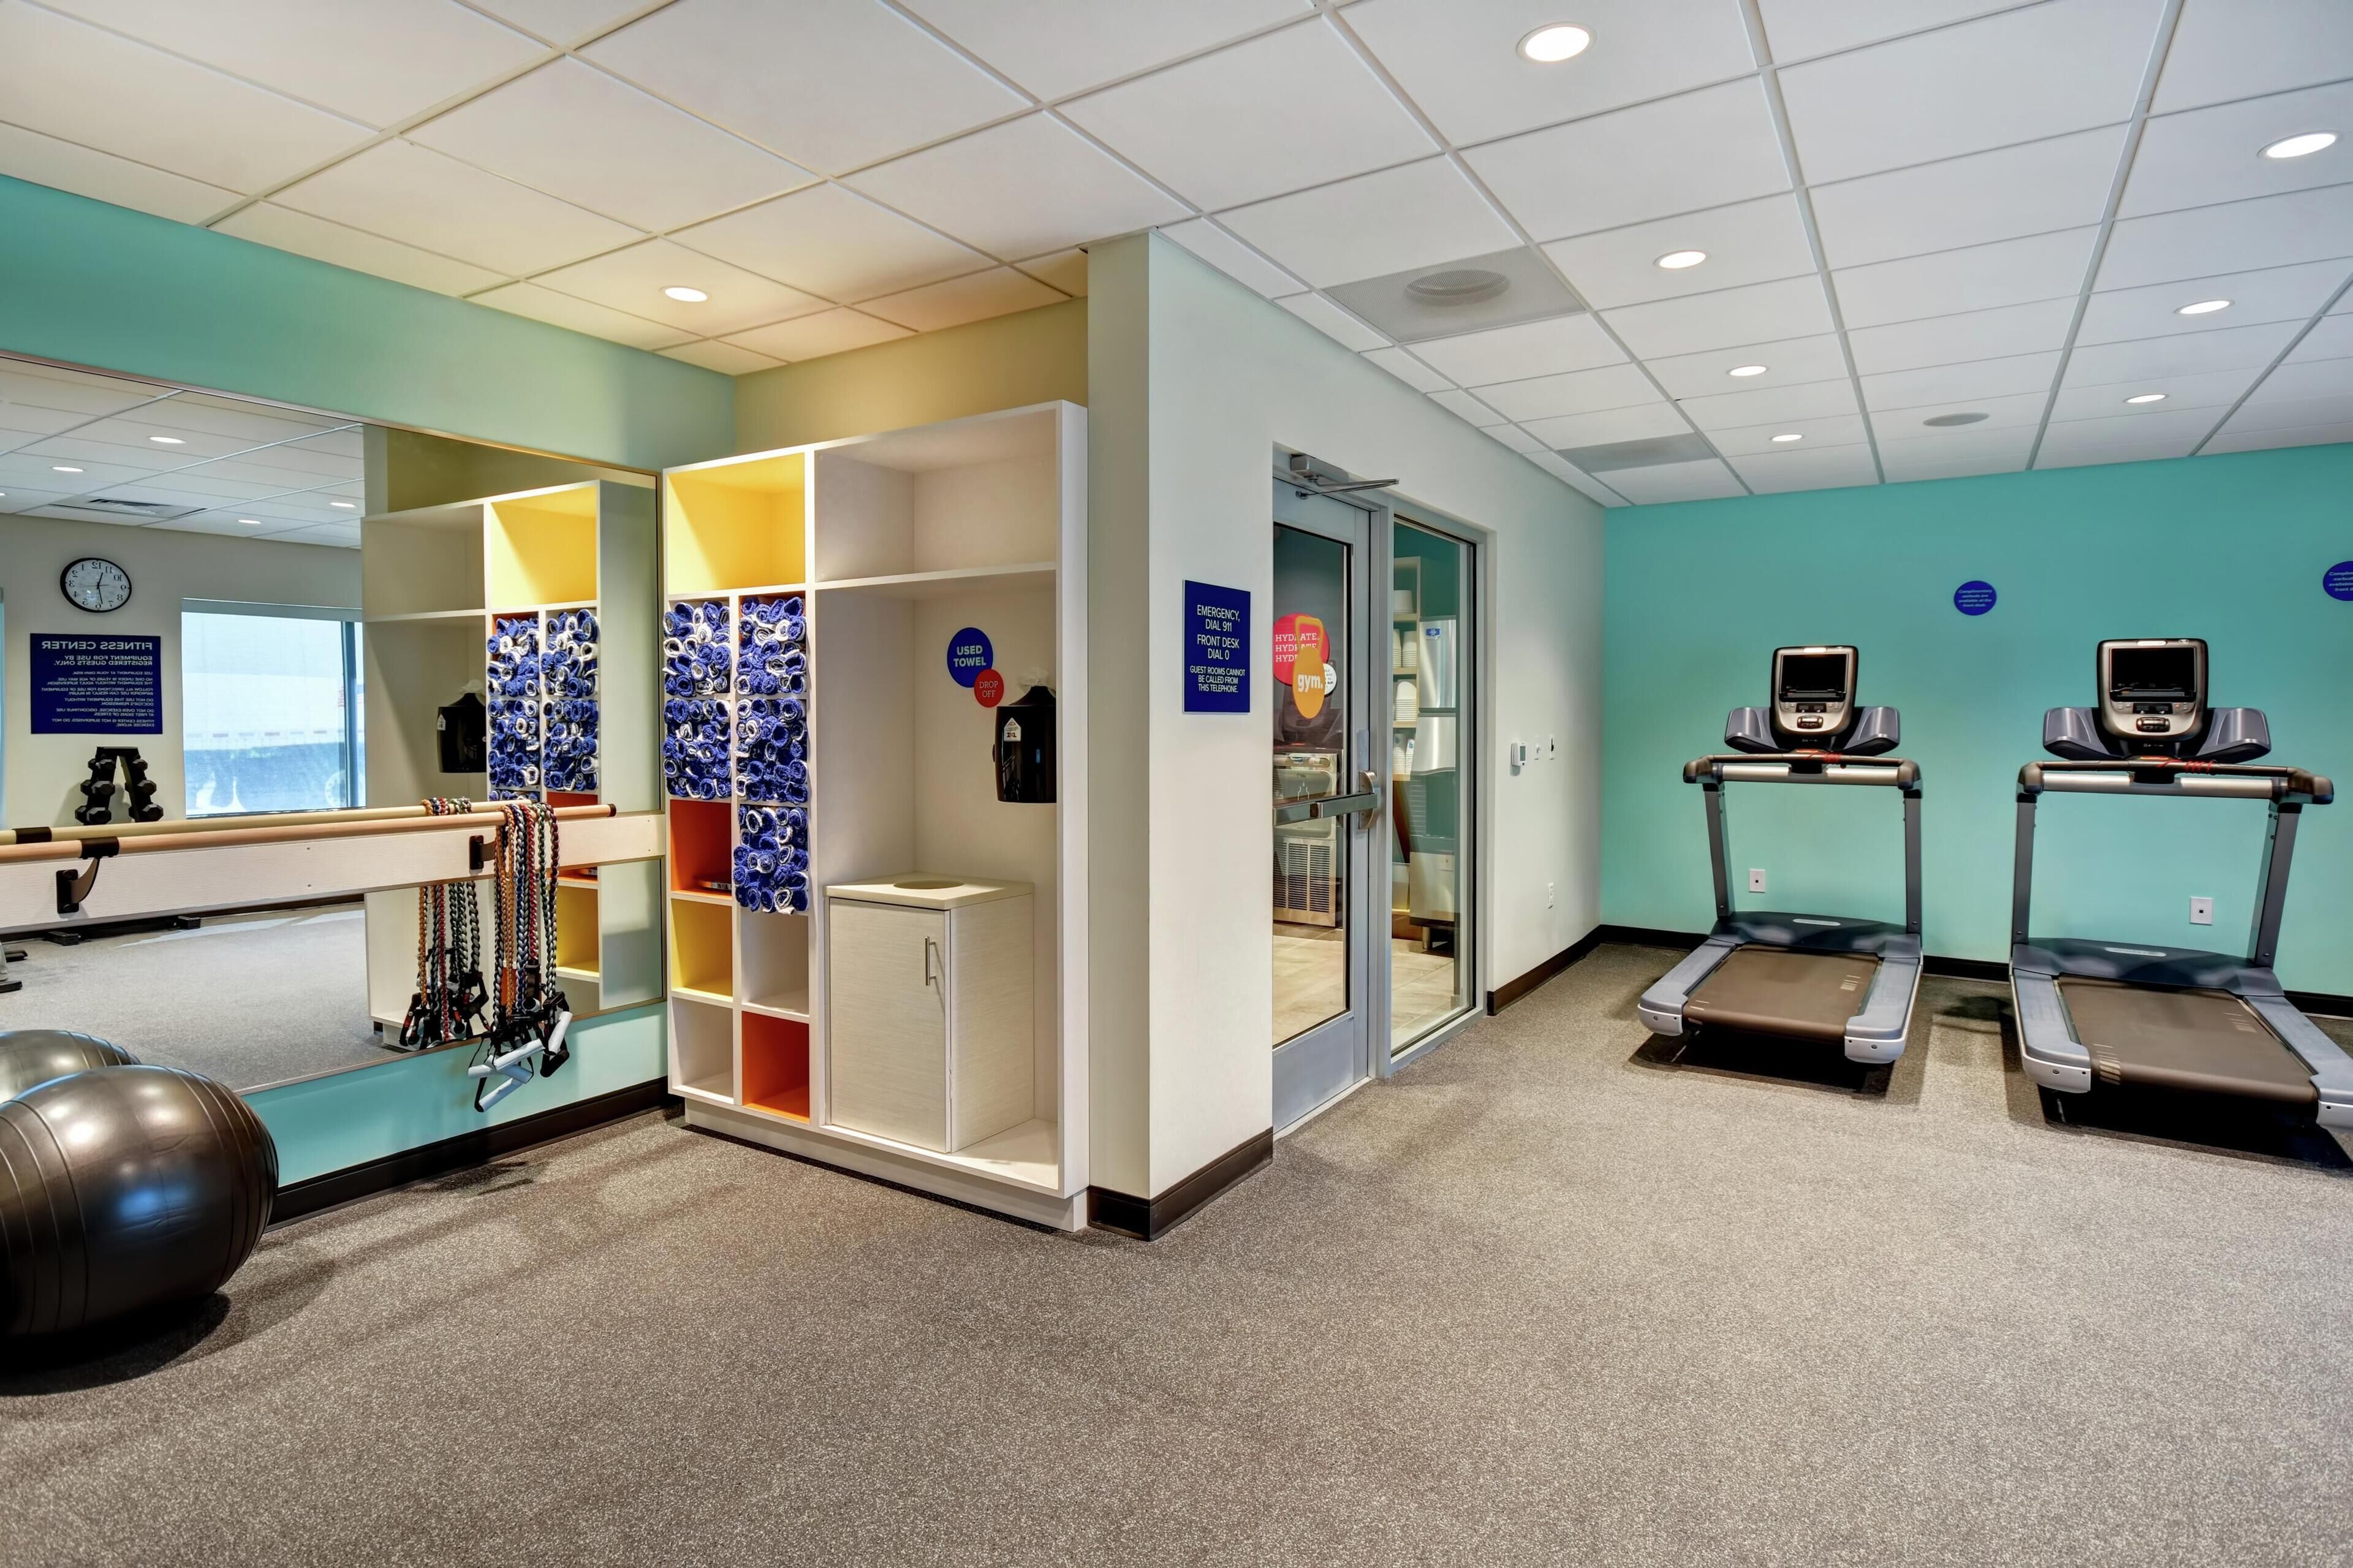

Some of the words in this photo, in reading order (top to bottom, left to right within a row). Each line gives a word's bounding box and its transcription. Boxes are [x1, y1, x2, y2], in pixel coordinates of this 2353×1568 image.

[1197, 605, 1240, 622] EMERGENCY,
[1205, 619, 1221, 631] DIAL
[1222, 621, 1232, 632] 911
[1197, 634, 1221, 646] FRONT
[1222, 637, 1240, 649] DESK
[957, 645, 983, 656] USED
[1208, 648, 1223, 659] DIAL
[953, 656, 987, 667] TOWEL
[1226, 668, 1245, 676] CANNOT
[979, 681, 999, 689] DROP
[1205, 675, 1224, 684] CALLED
[1298, 674, 1324, 692] gym.
